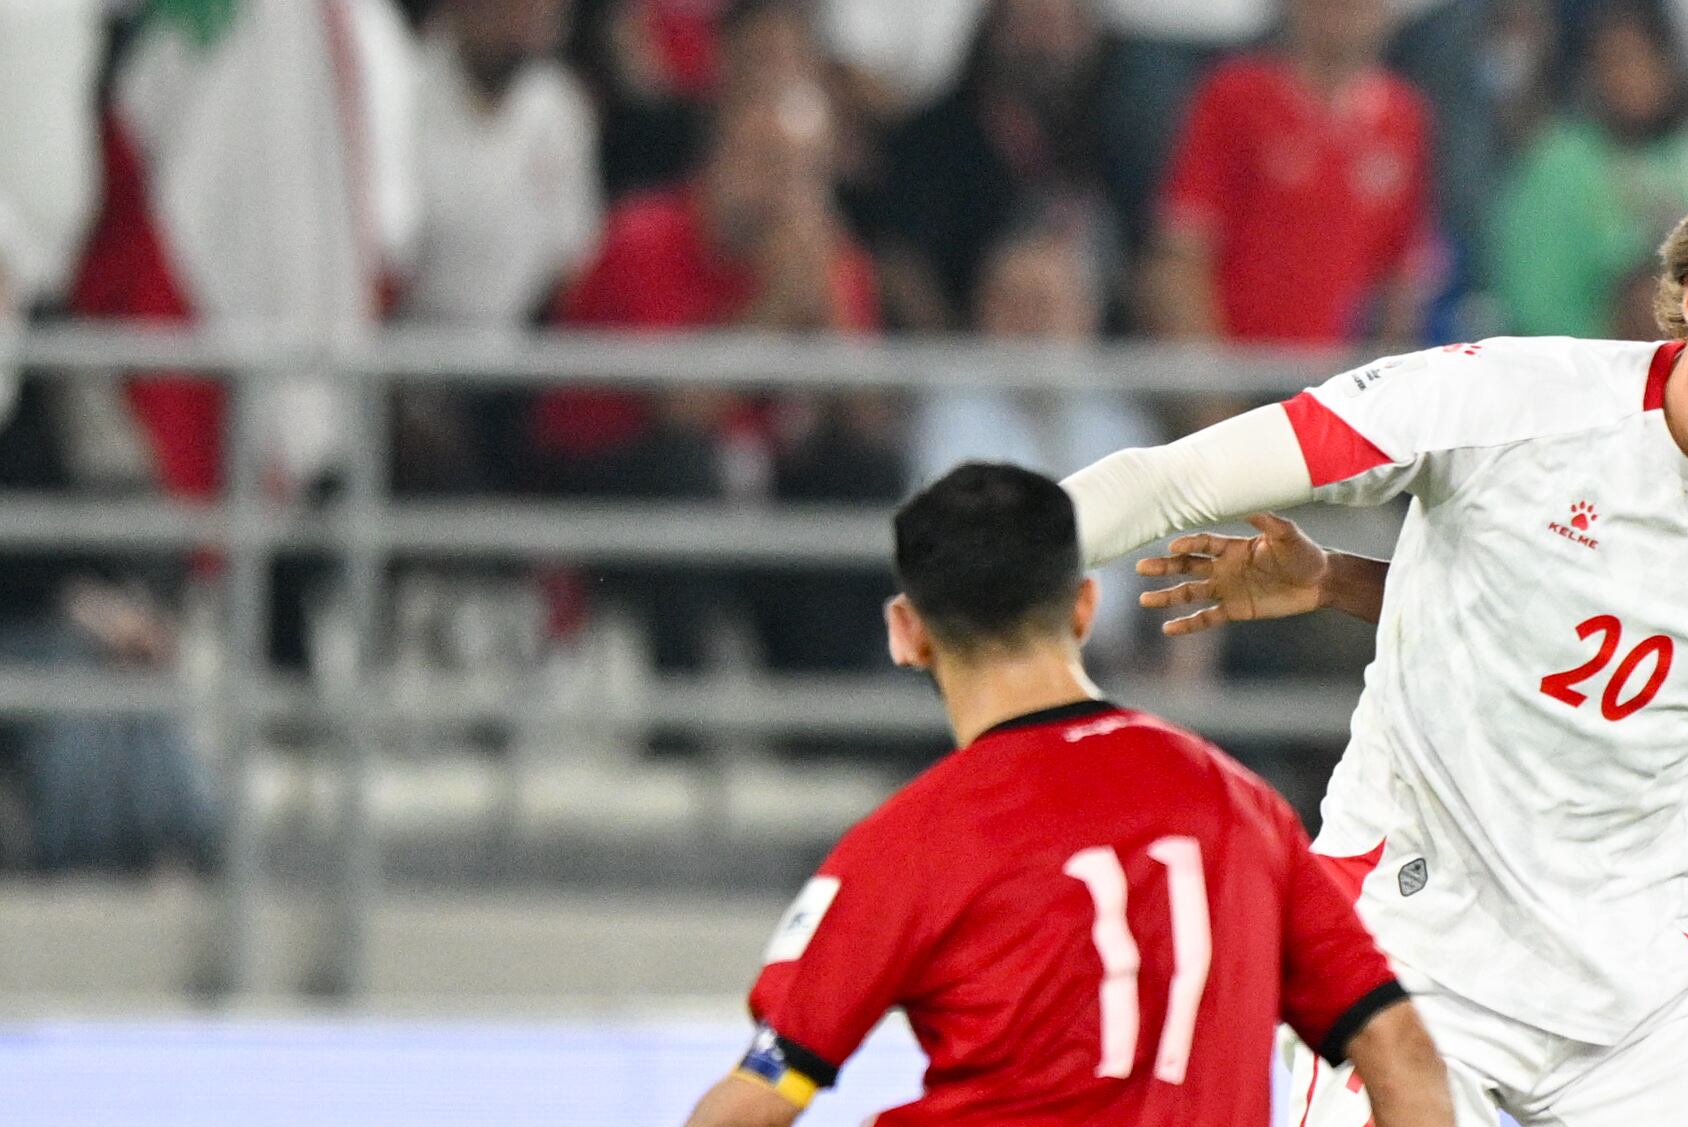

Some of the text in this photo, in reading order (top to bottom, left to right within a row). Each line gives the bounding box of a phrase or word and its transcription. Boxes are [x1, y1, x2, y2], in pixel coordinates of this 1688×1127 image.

[1548, 522, 1599, 549] KELME
[1540, 614, 1673, 722] 20
[1062, 835, 1213, 1086] 11
